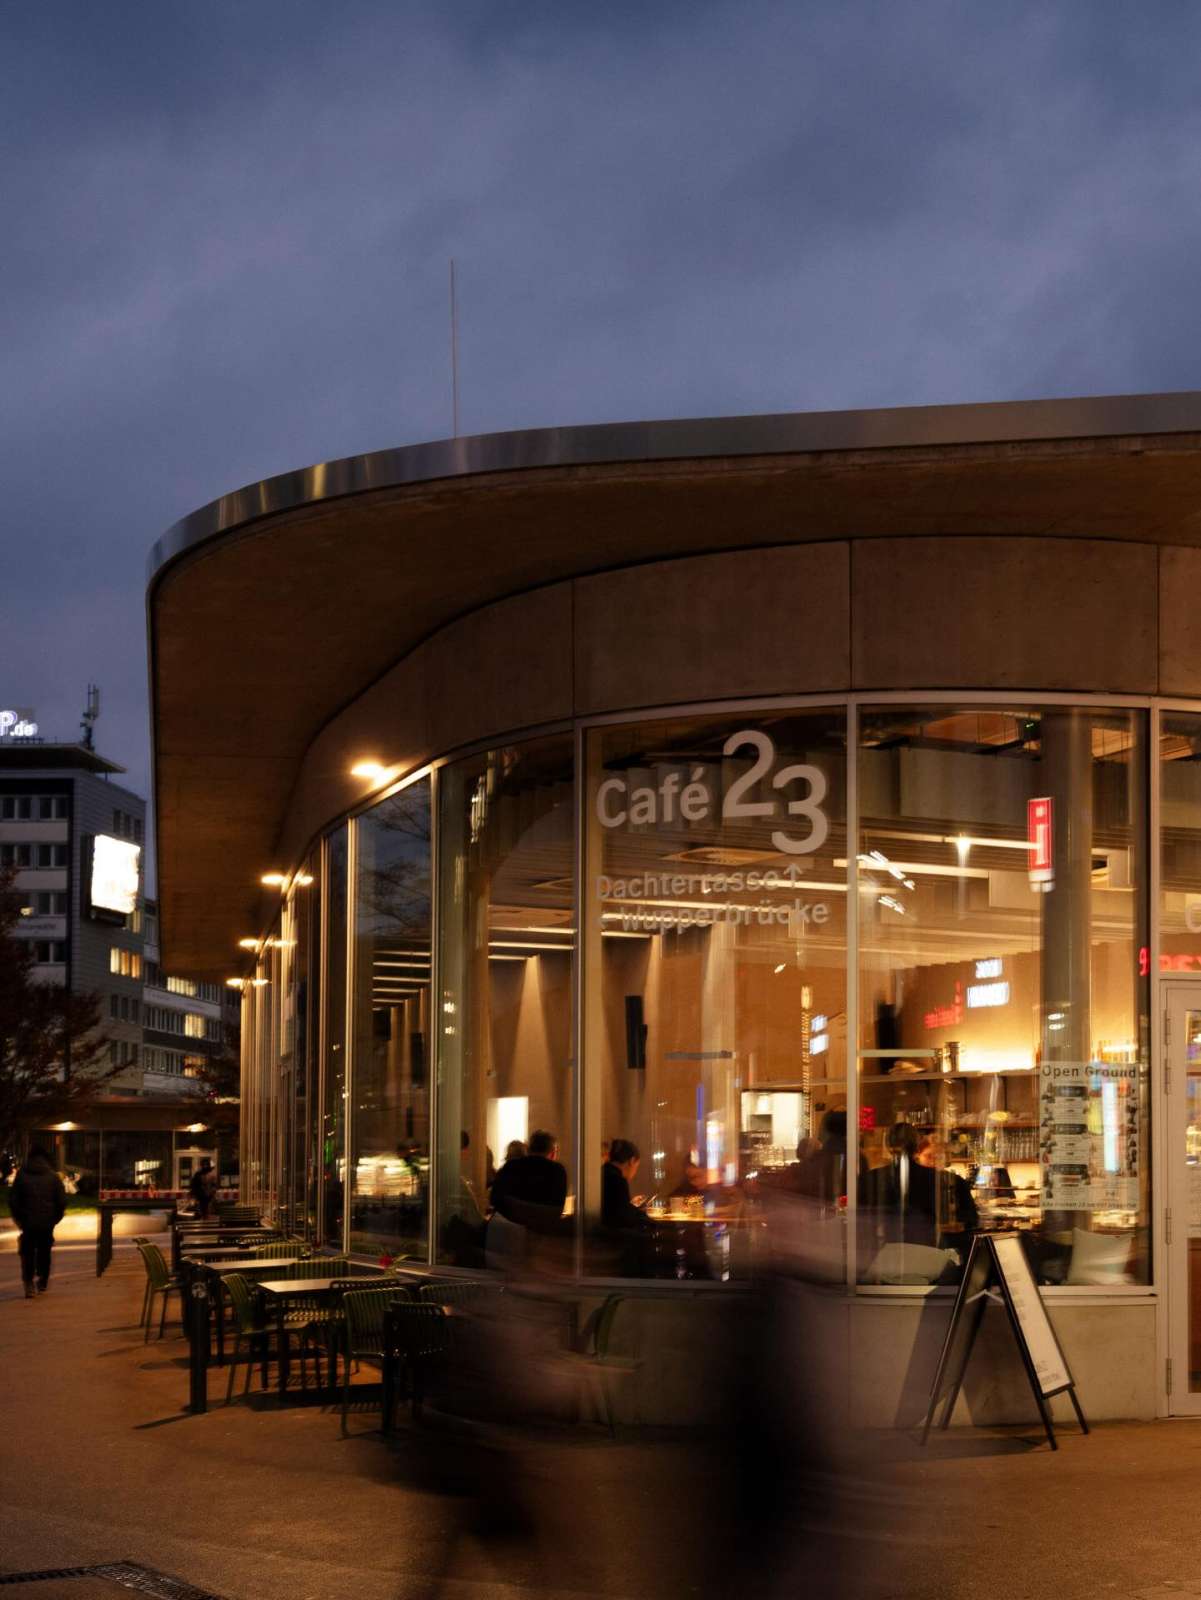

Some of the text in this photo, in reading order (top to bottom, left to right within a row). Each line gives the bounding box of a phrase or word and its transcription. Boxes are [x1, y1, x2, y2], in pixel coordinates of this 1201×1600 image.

[597, 730, 828, 854] Café 23
[595, 868, 779, 899] Dachterrasse
[1042, 1066, 1136, 1079] Open Ground
